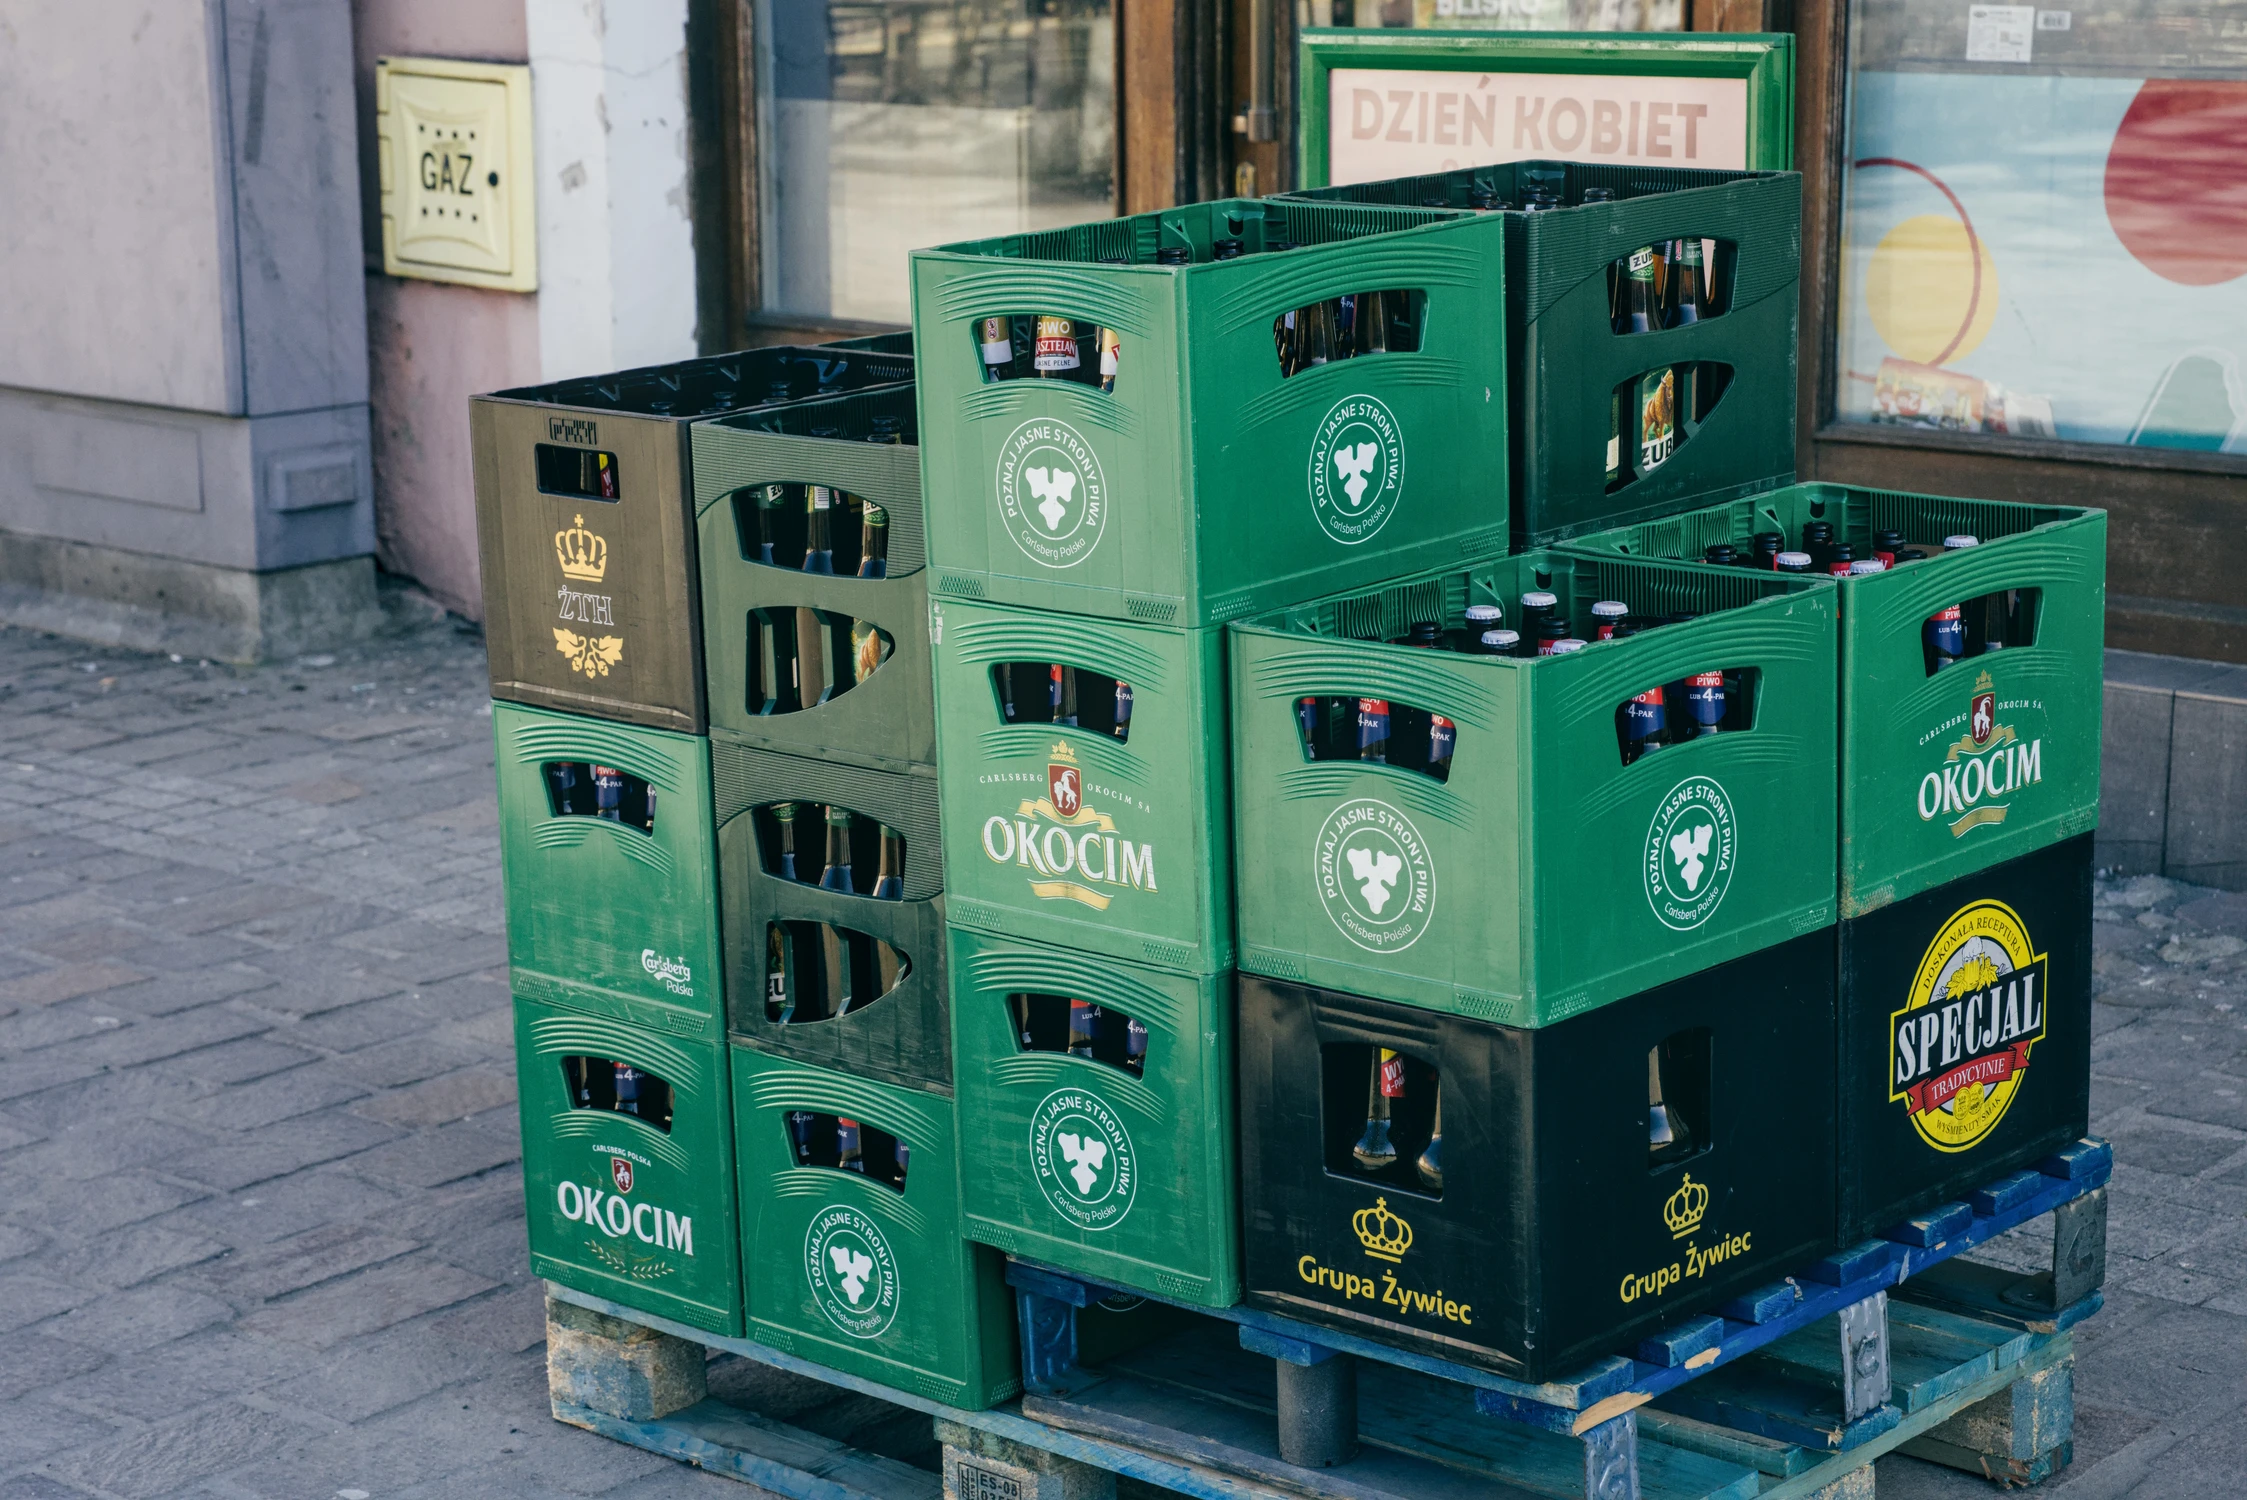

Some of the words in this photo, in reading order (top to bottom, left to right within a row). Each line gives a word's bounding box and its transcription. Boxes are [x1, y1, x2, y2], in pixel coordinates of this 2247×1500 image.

[1351, 74, 1496, 148] DZIEŃ
[1512, 96, 1708, 160] KOBIET
[421, 151, 474, 196] GAZ
[1037, 320, 1070, 334] PIWO
[1314, 440, 1328, 508] POZNAJ
[1325, 403, 1357, 440] JASNE
[1358, 403, 1396, 445] STRONY
[1386, 447, 1399, 490] PIWA
[1002, 451, 1018, 518] POZNAJ
[1014, 426, 1051, 454] JASNE
[1053, 428, 1097, 481] STRONY
[1086, 485, 1100, 527] PIWA
[1329, 515, 1362, 536] Carlsberg
[1362, 504, 1386, 531] Polska
[1021, 530, 1059, 561] Carlsberg
[1060, 538, 1086, 558] Polska
[557, 584, 615, 626] ŻTH
[1696, 677, 1720, 686] PIWO
[1357, 712, 1379, 728] 4-PAK
[1627, 703, 1654, 718] 4-PAK
[1919, 712, 1967, 746] CARLSBERG
[1998, 700, 2029, 711] OKOCIM
[2032, 700, 2042, 710] SA
[1430, 725, 1450, 742] 4-PAK
[600, 776, 623, 789] 4-PAK
[979, 773, 1044, 784] CARLSBERG
[1087, 783, 1132, 805] OKOCIM
[1137, 801, 1151, 813] SA
[1918, 738, 2042, 821] OKOCIM
[981, 815, 1159, 893] OKOCIM
[1321, 831, 1339, 899] POZNAJ
[1335, 807, 1375, 834] JASNE
[1378, 810, 1425, 867] STRONY
[1412, 870, 1428, 913] PIWA
[1650, 825, 1664, 896] POZNAJ
[1661, 786, 1694, 826] JASNE
[1695, 785, 1730, 826] STRONY
[1718, 827, 1731, 872] PIWA
[1664, 901, 1697, 921] Carlsberg
[1697, 886, 1719, 915] Polska
[1341, 912, 1382, 946] Carlsberg
[1383, 923, 1412, 943] Polska
[641, 948, 691, 983] Carlsberg
[1923, 921, 1974, 990] DOSKONAŁA
[1976, 916, 2021, 957] RECEPTURA
[666, 980, 694, 997] Polska
[1897, 972, 2042, 1086] SPECJAL
[1931, 1057, 2006, 1101] TRADYCYJNIE
[1981, 1096, 2001, 1122] SMAK
[592, 1144, 627, 1157] CARLSBERG
[627, 1150, 652, 1168] POLSKA
[1036, 1115, 1051, 1177] POZNAJ
[1047, 1096, 1082, 1119] JASNE
[1085, 1100, 1127, 1153] STRONY
[1116, 1156, 1130, 1196] PIWA
[557, 1180, 694, 1257] OKOCIM
[1053, 1190, 1091, 1223] Carlsberg
[1091, 1204, 1117, 1221] Polska
[810, 1229, 825, 1287] POZNAJ
[820, 1212, 852, 1233] JASNE
[853, 1216, 891, 1268] STRONY
[881, 1270, 893, 1308] PIWA
[1620, 1262, 1681, 1303] Grupa
[1685, 1231, 1752, 1278] Żywiec
[1298, 1255, 1375, 1299] Grupa
[1381, 1268, 1472, 1325] Żywiec
[826, 1299, 860, 1331] Carlsberg
[860, 1315, 881, 1330] Polska
[980, 1473, 1018, 1497] ES-08
